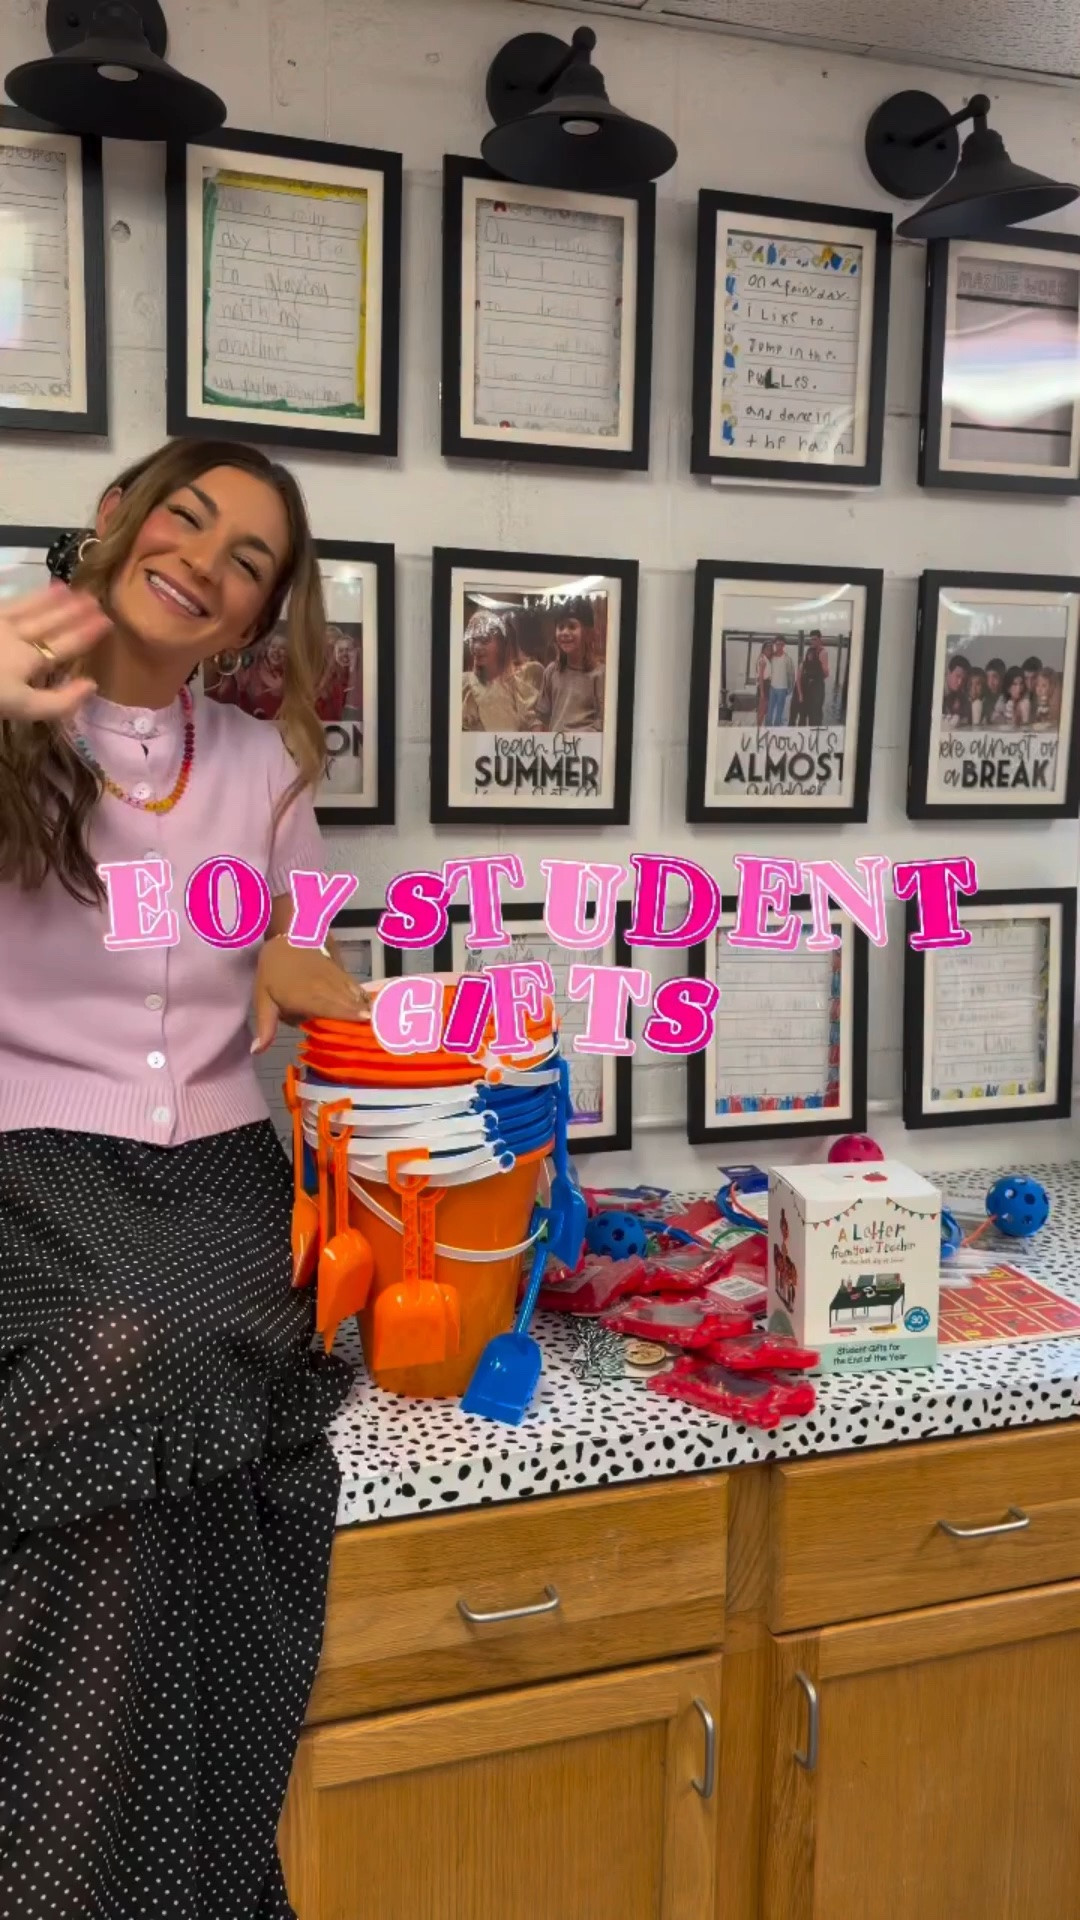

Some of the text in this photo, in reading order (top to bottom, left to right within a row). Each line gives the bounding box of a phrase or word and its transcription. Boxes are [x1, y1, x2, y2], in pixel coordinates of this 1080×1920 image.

[475, 756, 600, 787] SUMMER
[723, 752, 845, 783] ALMOST
[961, 759, 1049, 788] BREAK
[838, 1220, 906, 1243] A Letter
[836, 1345, 866, 1356] Student
